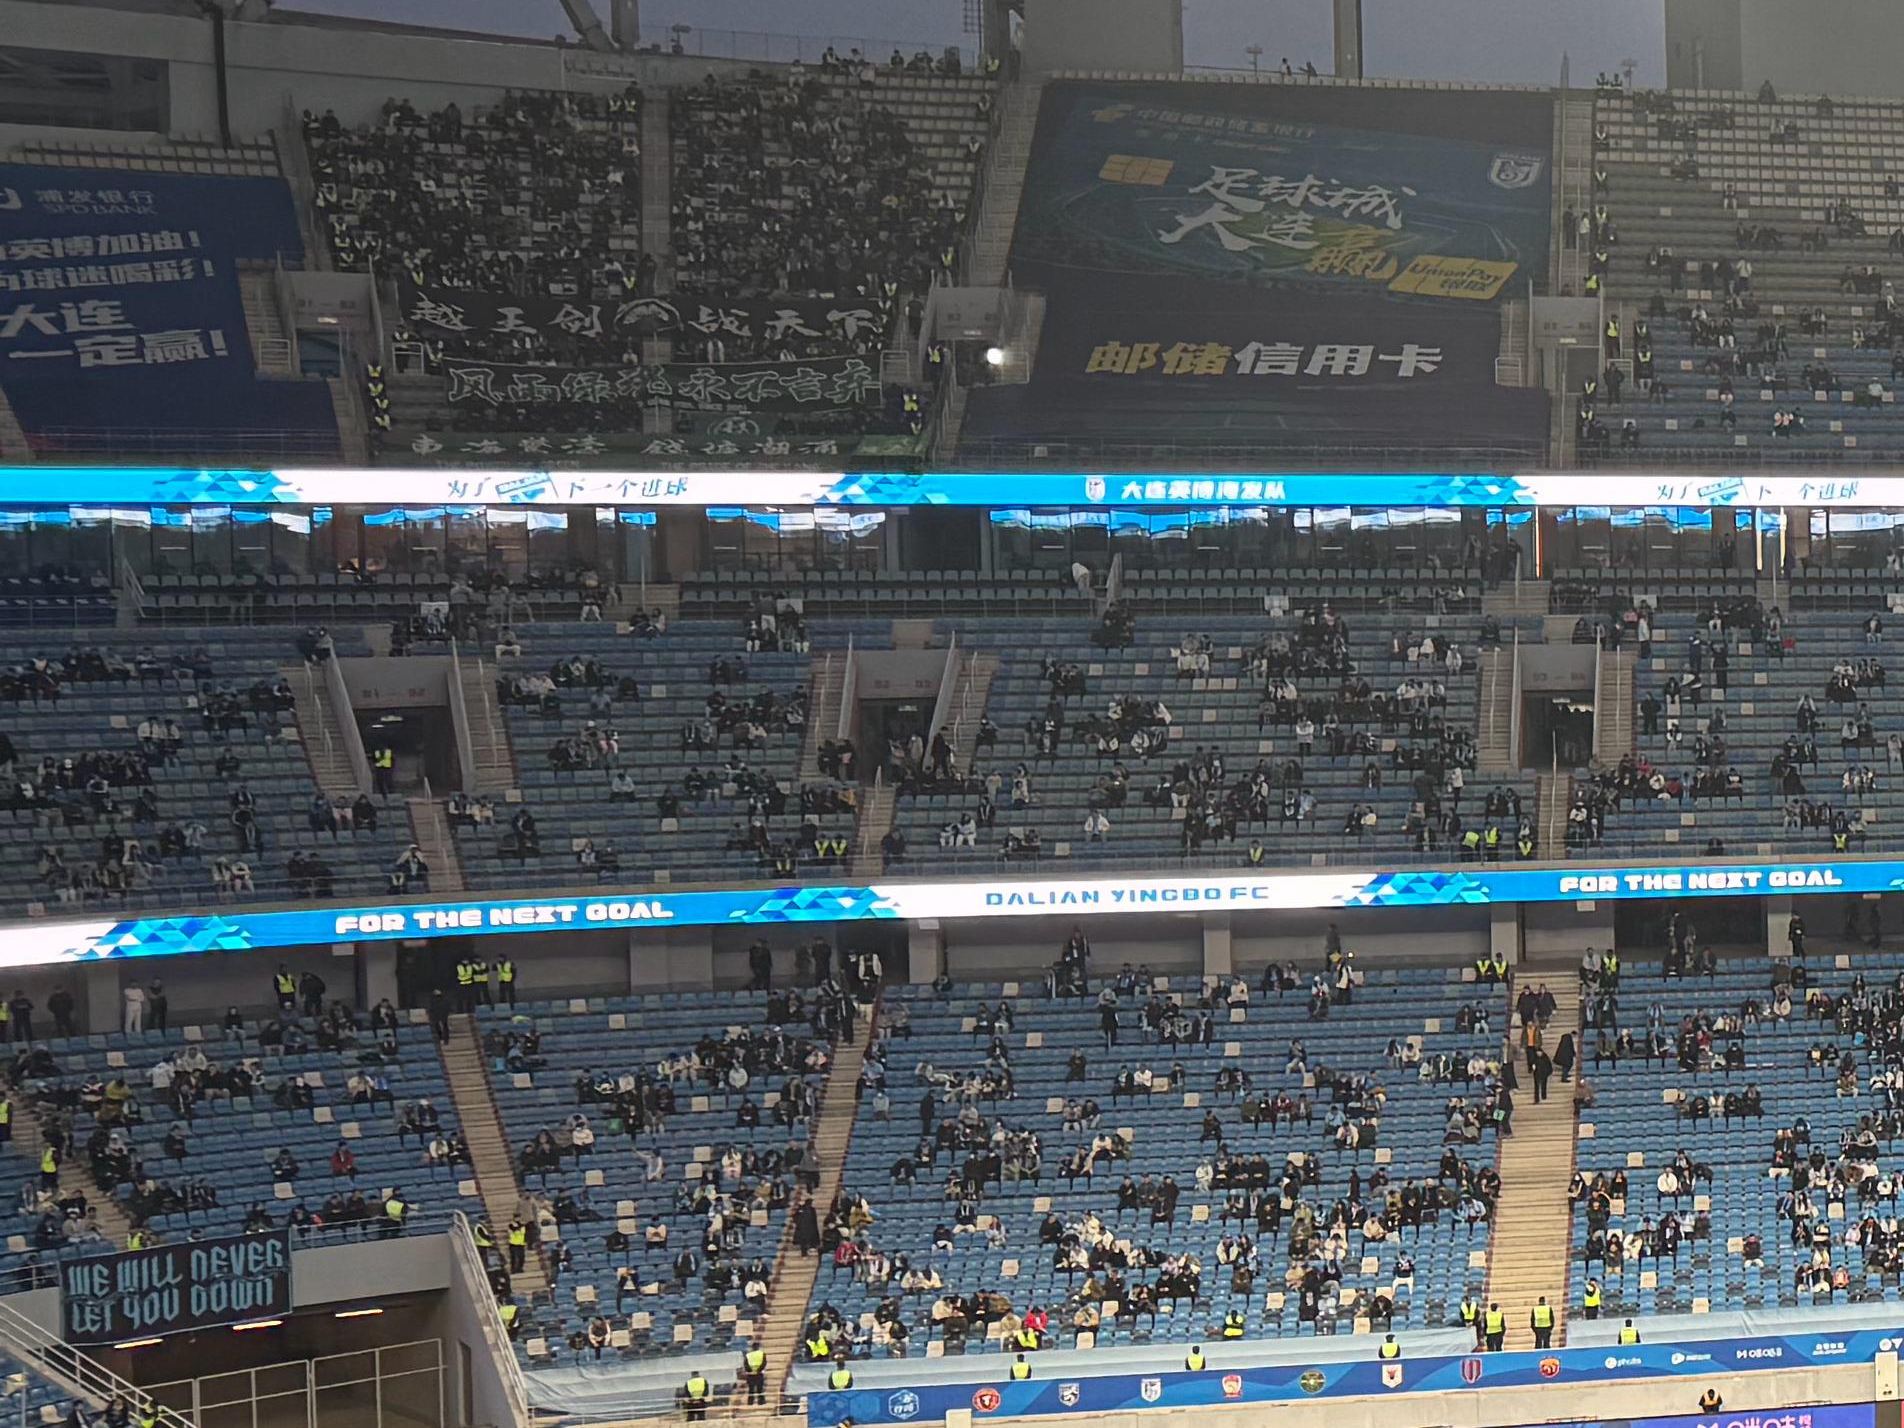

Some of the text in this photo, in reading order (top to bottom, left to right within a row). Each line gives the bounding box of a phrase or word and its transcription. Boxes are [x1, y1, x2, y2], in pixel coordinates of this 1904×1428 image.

[1188, 164, 1418, 229] 足球城
[0, 299, 136, 338] 大连
[1085, 339, 1444, 378] 邮储信用卡
[985, 890, 1100, 906] DALIAN
[1229, 886, 1270, 900] FC
[1559, 869, 1843, 894] FOR THE NEXT GOAL
[335, 900, 674, 935] FOR THE NEXT GOAL
[68, 1238, 284, 1298] WE WILL NEVER
[71, 1277, 274, 1334] LET YOU DOWN
